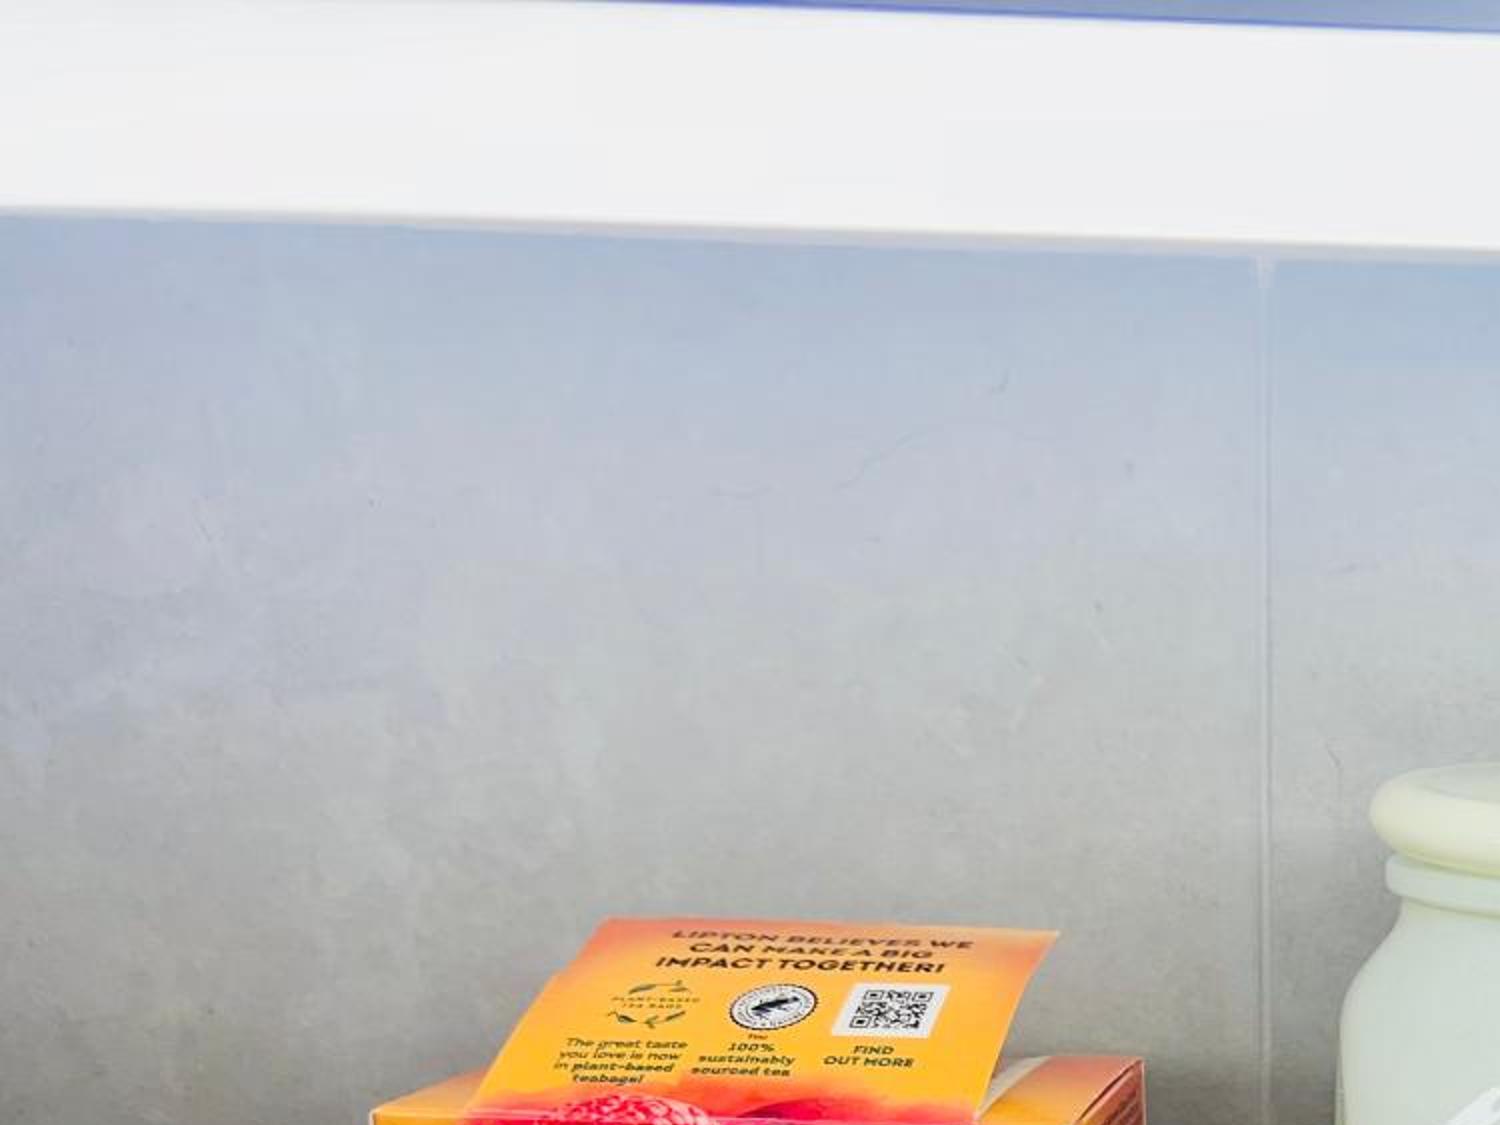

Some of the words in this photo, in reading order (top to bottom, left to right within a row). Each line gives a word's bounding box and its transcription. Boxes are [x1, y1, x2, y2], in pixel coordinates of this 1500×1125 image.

[672, 930, 778, 942] LIPTON
[786, 935, 920, 948] BELIEVES
[930, 939, 975, 949] WE
[690, 942, 754, 953] CAN
[763, 945, 844, 956] MAKE
[849, 949, 873, 957] A
[880, 949, 934, 959] BIG
[655, 956, 773, 969] IMPACT
[778, 958, 945, 973] TOGETHER!
[566, 1037, 595, 1049] The
[597, 1038, 642, 1051] great
[645, 1041, 689, 1050] taste
[728, 1042, 776, 1053] 100%
[852, 1045, 895, 1055] FIND
[558, 1050, 590, 1061] you
[592, 1050, 628, 1061] love
[630, 1051, 643, 1061] is
[647, 1053, 682, 1061] now
[698, 1053, 796, 1067] sustainably
[823, 1055, 860, 1065] OUT
[863, 1057, 915, 1068] MORE
[554, 1063, 569, 1071] in
[570, 1062, 676, 1073] plant-based
[691, 1066, 761, 1077] sourced
[763, 1067, 792, 1077] tea
